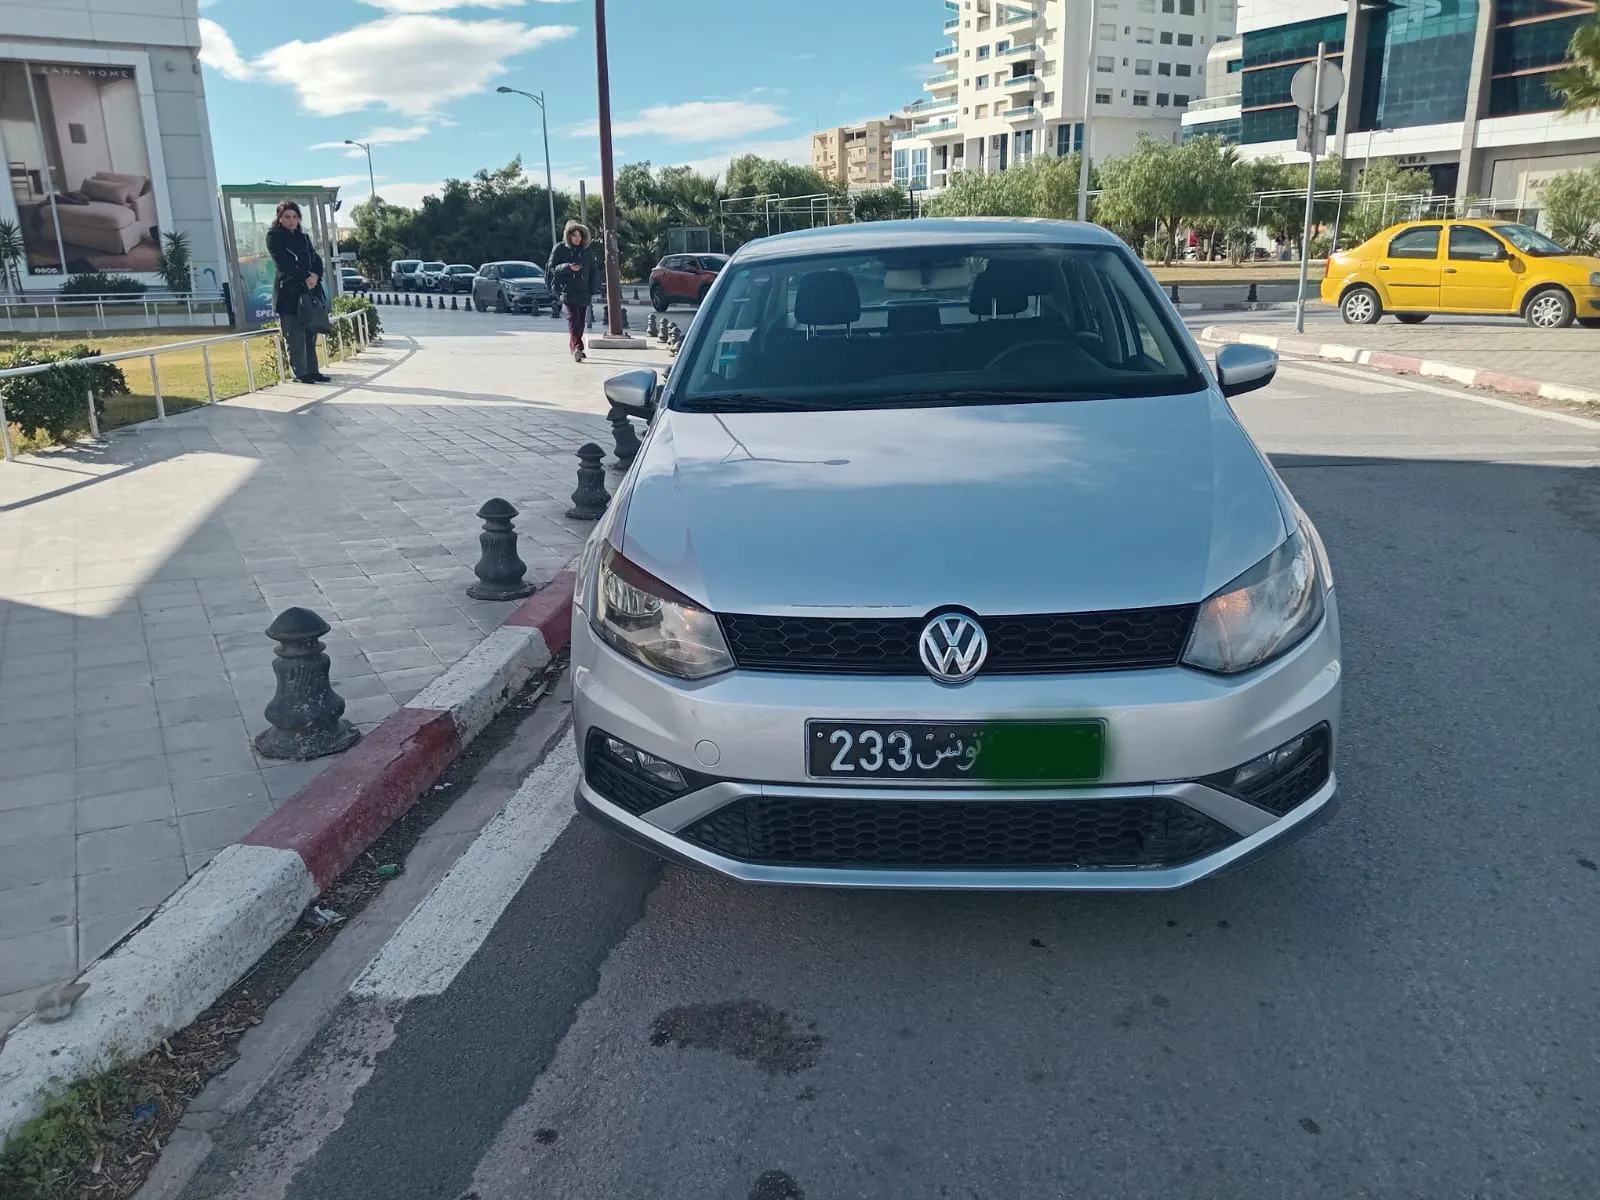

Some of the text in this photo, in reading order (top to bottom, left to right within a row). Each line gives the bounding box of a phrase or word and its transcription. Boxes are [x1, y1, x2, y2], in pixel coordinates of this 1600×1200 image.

[41, 66, 129, 78] ZARA HOME
[829, 729, 985, 772] 233 تونس
